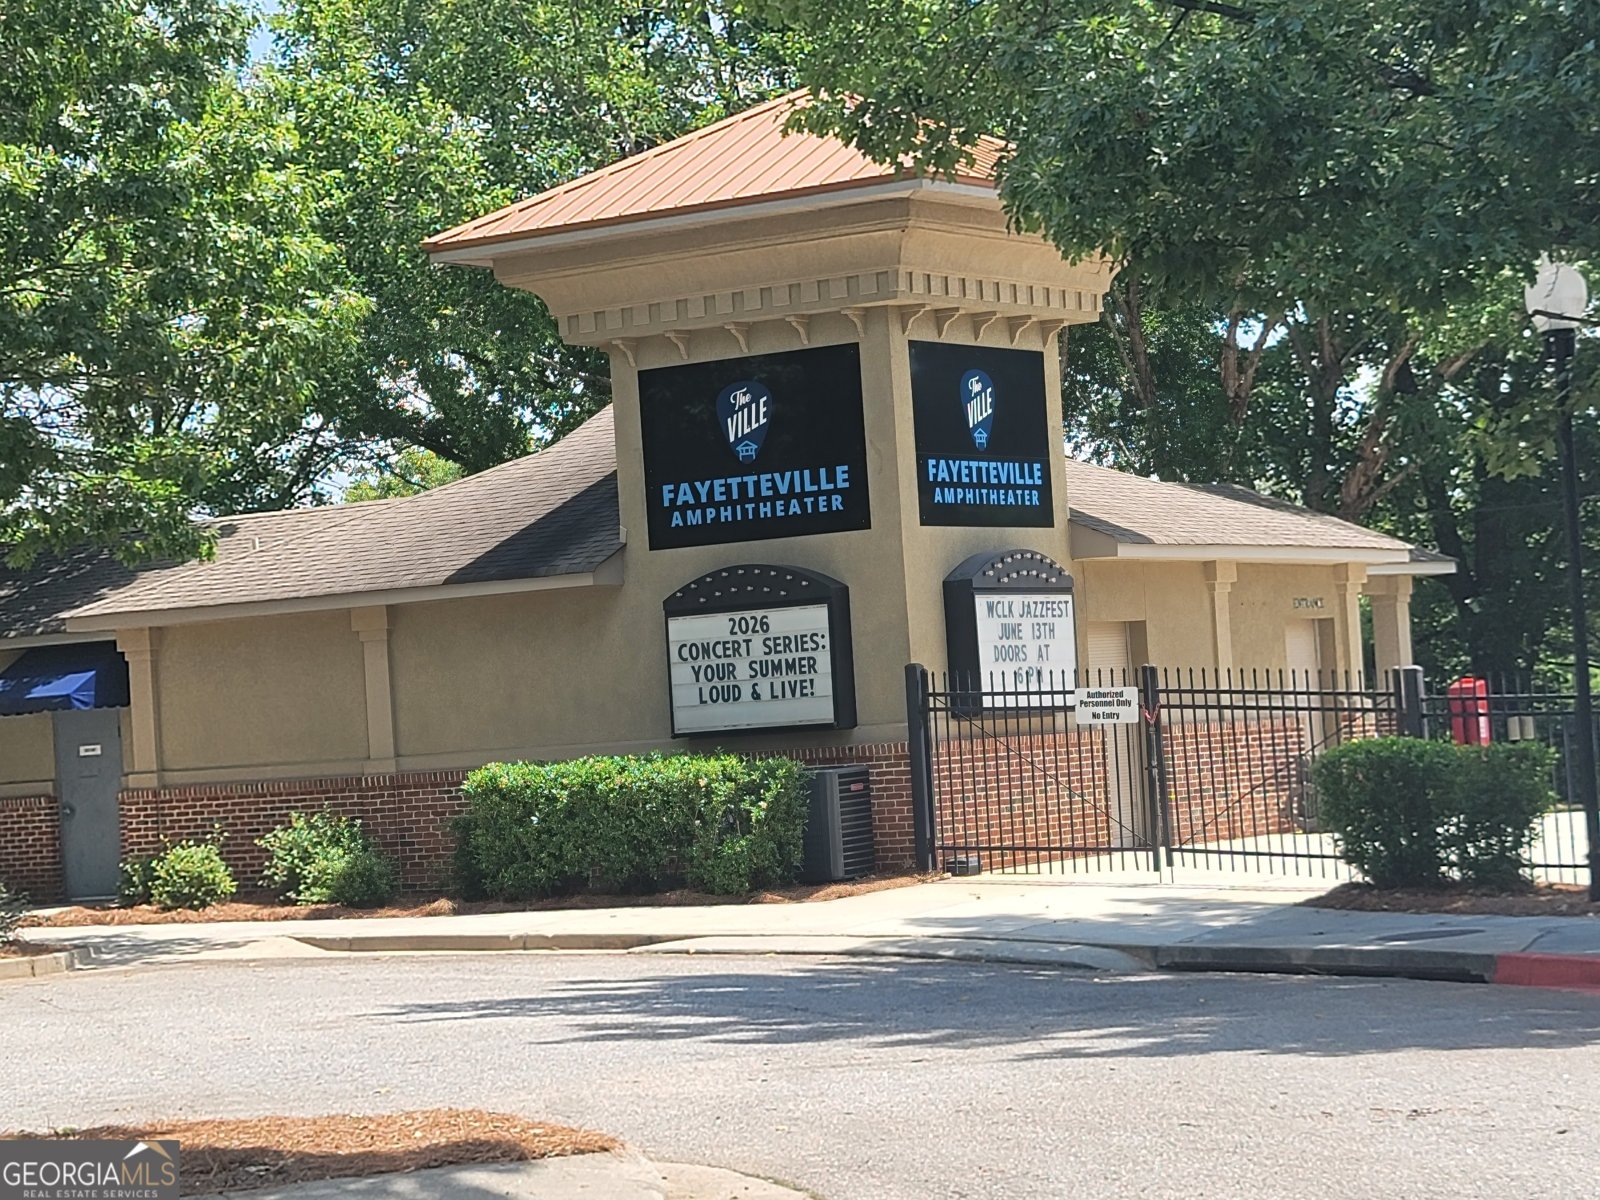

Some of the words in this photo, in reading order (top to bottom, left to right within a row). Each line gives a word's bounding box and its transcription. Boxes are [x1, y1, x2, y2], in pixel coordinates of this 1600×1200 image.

[968, 375, 983, 397] The
[730, 387, 751, 411] The
[967, 387, 993, 428] VILLE
[727, 396, 767, 443] VILLE
[928, 459, 1042, 485] FAYETTEVILLE
[662, 465, 850, 507] FAYETTEVILLE
[934, 487, 1040, 506] AMPHITHEATER
[670, 494, 844, 528] AMPHITHEATER
[986, 601, 1014, 618] WCLK
[1019, 600, 1069, 618] JAZZFEST
[728, 615, 770, 635] 2026
[998, 622, 1023, 640] JUNE
[1032, 622, 1055, 640] 13TH
[677, 638, 753, 662] CONCERT
[762, 632, 826, 656] SERIES:
[994, 645, 1027, 662] DOORS
[1038, 644, 1050, 661] AT
[691, 662, 737, 683] YOUR
[749, 656, 818, 679] SUMMER
[699, 684, 741, 705] LOUD
[750, 682, 761, 701] &
[770, 678, 815, 699] LIVE!
[1086, 690, 1124, 699] Authorized
[1080, 699, 1115, 708] Personnel
[1116, 699, 1132, 708] Only
[1092, 711, 1101, 720] No
[1102, 711, 1120, 721] Entry
